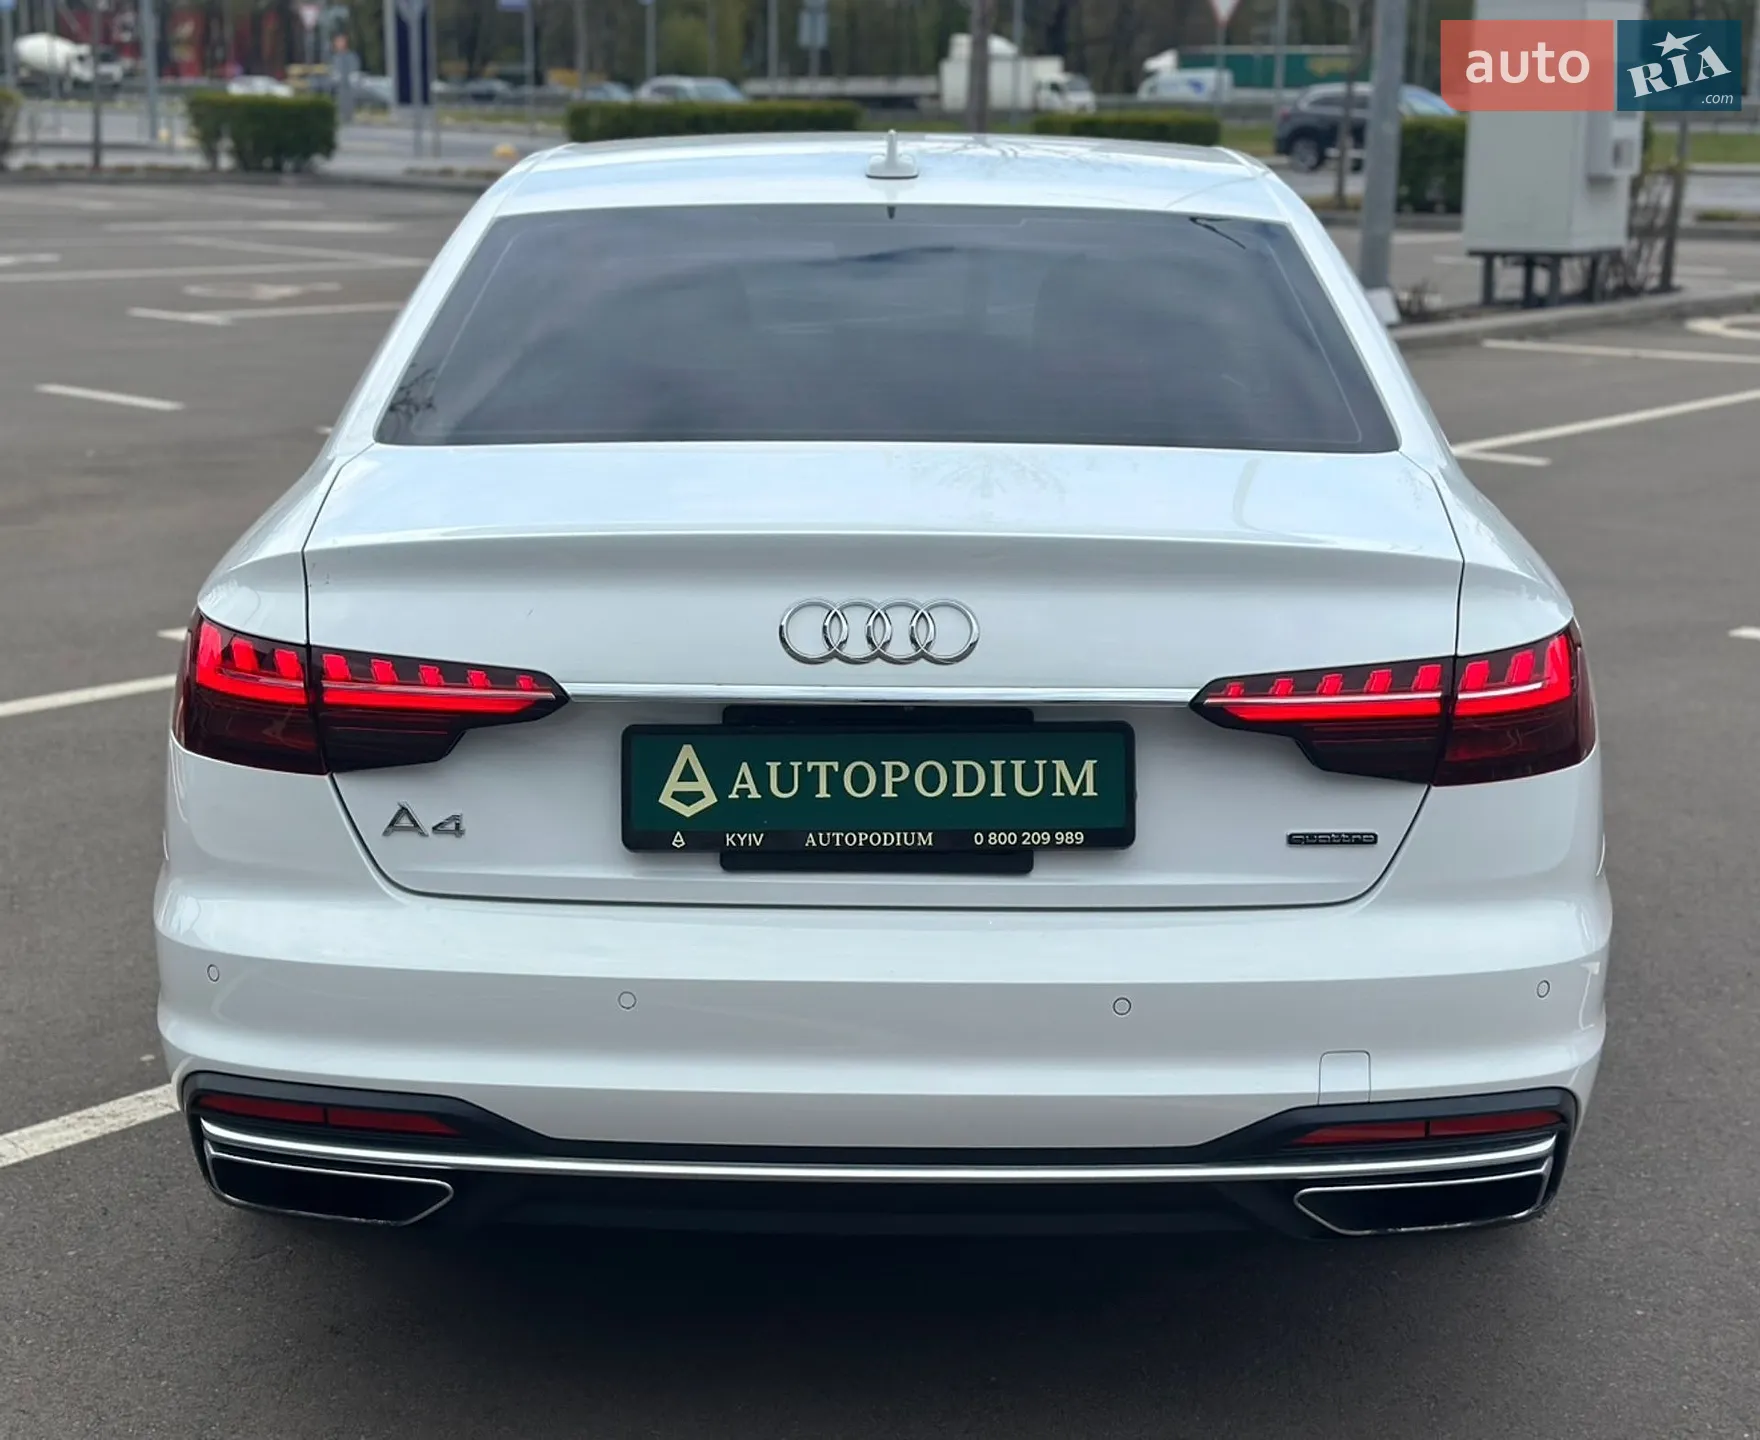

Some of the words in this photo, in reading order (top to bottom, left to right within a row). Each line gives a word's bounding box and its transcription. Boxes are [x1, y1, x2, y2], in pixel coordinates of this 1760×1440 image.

[728, 760, 1098, 799] AUTOPODIUM
[382, 800, 465, 838] A4
[725, 833, 764, 847] KYIV
[805, 831, 933, 847] AUTOPODIUM
[974, 832, 984, 846] 0
[987, 832, 1017, 846] 800
[1021, 831, 1050, 846] 209
[1054, 831, 1084, 845] 989
[1290, 833, 1376, 845] quattro
